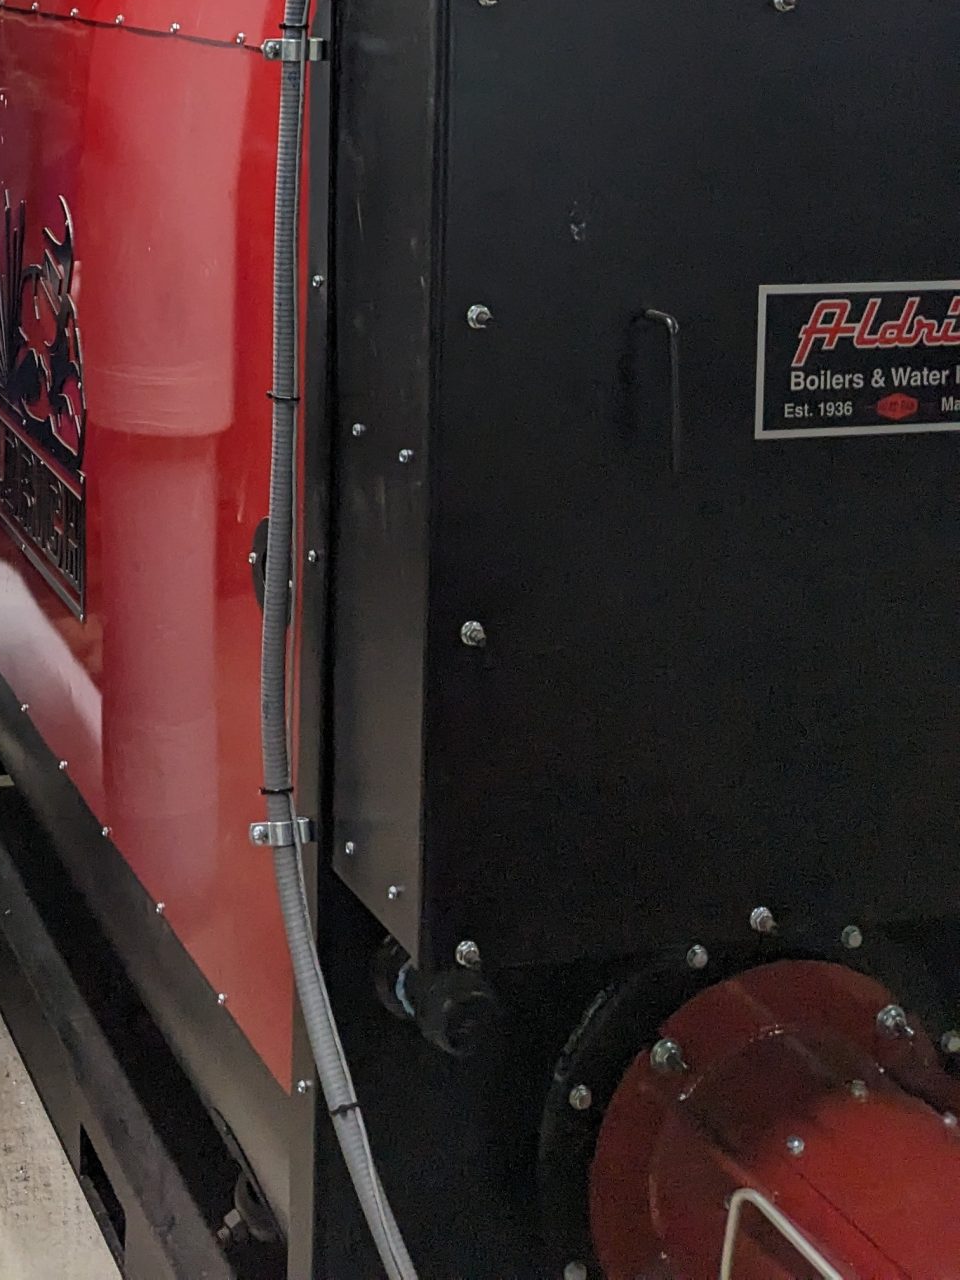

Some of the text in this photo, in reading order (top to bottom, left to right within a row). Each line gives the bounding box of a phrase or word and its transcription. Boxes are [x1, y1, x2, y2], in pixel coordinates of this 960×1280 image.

[790, 369, 864, 391] Boilers
[871, 368, 885, 388] &
[891, 366, 949, 387] Water
[784, 401, 853, 418] Est. 1936
